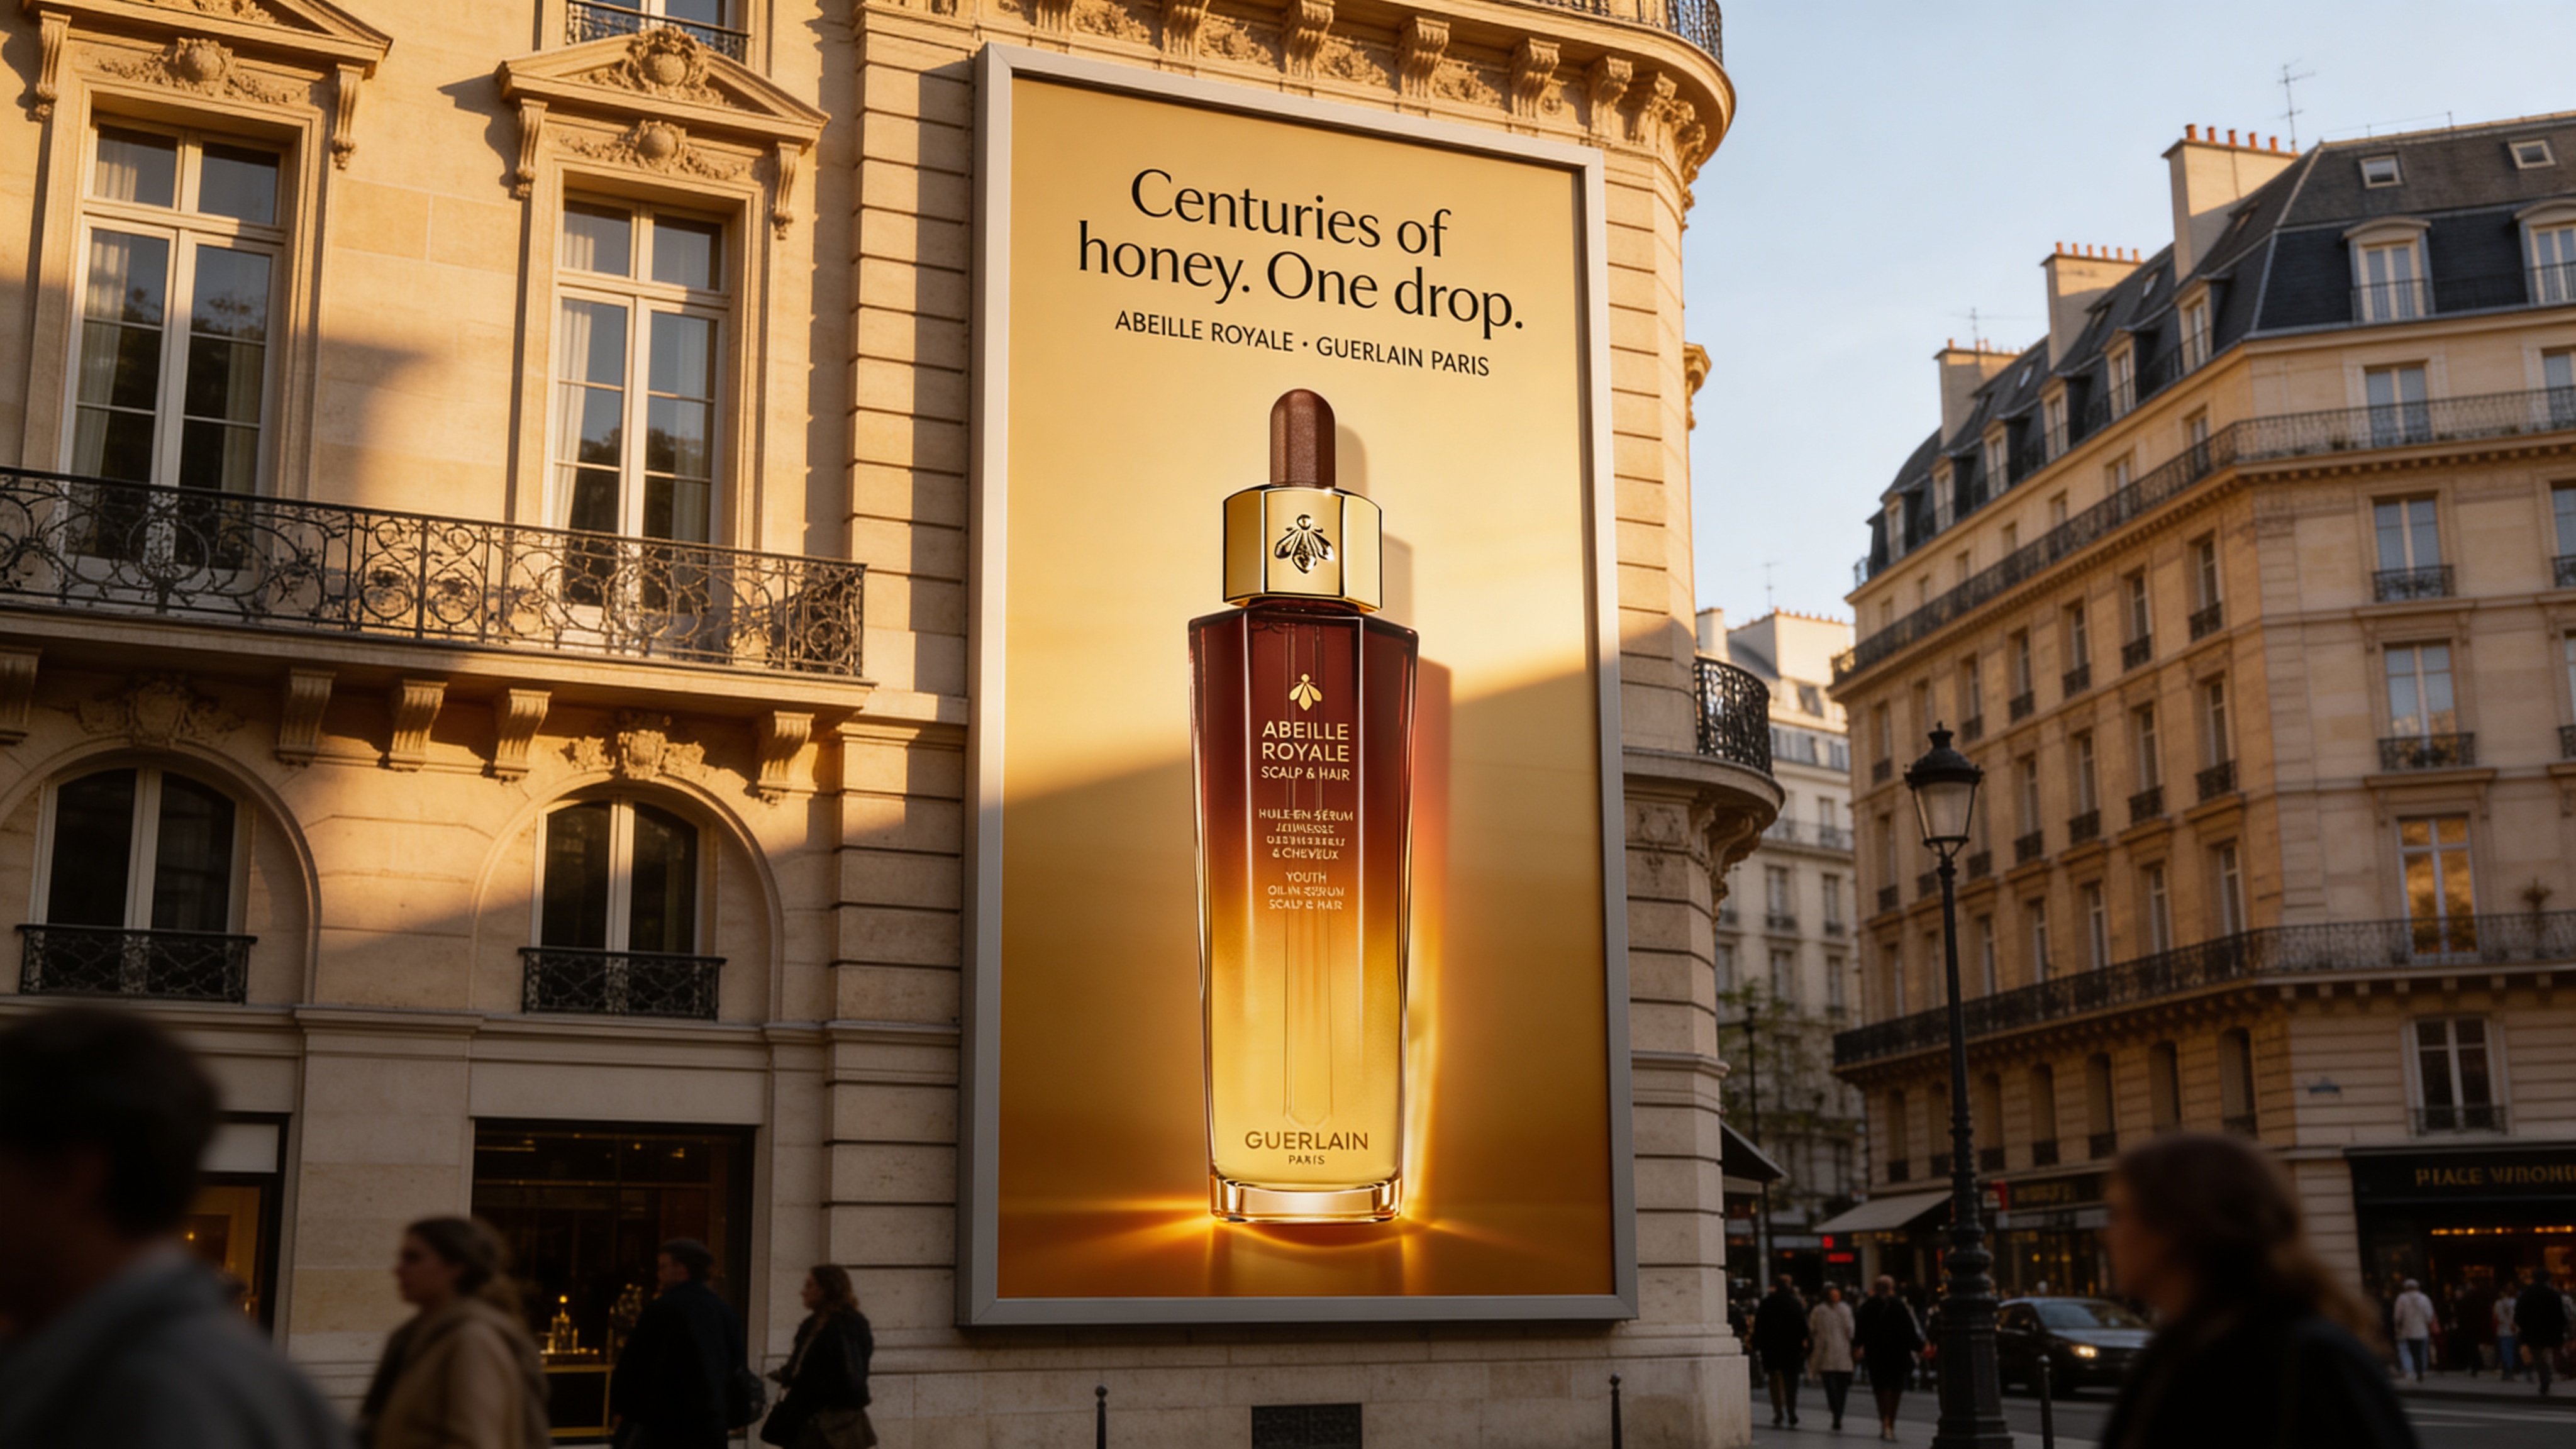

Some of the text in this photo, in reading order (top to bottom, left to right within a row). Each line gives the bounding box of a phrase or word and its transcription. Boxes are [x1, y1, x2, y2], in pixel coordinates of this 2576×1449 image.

[1131, 169, 1452, 257] Centuries of
[1079, 220, 1523, 340] honey. One drop.
[1115, 310, 1202, 340] ABEILLE
[1211, 322, 1294, 352] ROYALE
[1316, 336, 1423, 368] GUERLAIN
[1431, 350, 1489, 377] PARIS
[1262, 721, 1350, 740] ABEILLE
[1262, 742, 1350, 762] ROYALE
[1261, 766, 1350, 780] SCALP & HAIR
[1285, 872, 1327, 884] YOUTH
[1245, 1131, 1368, 1150] GUERLAIN
[1289, 1155, 1325, 1165] PARIS
